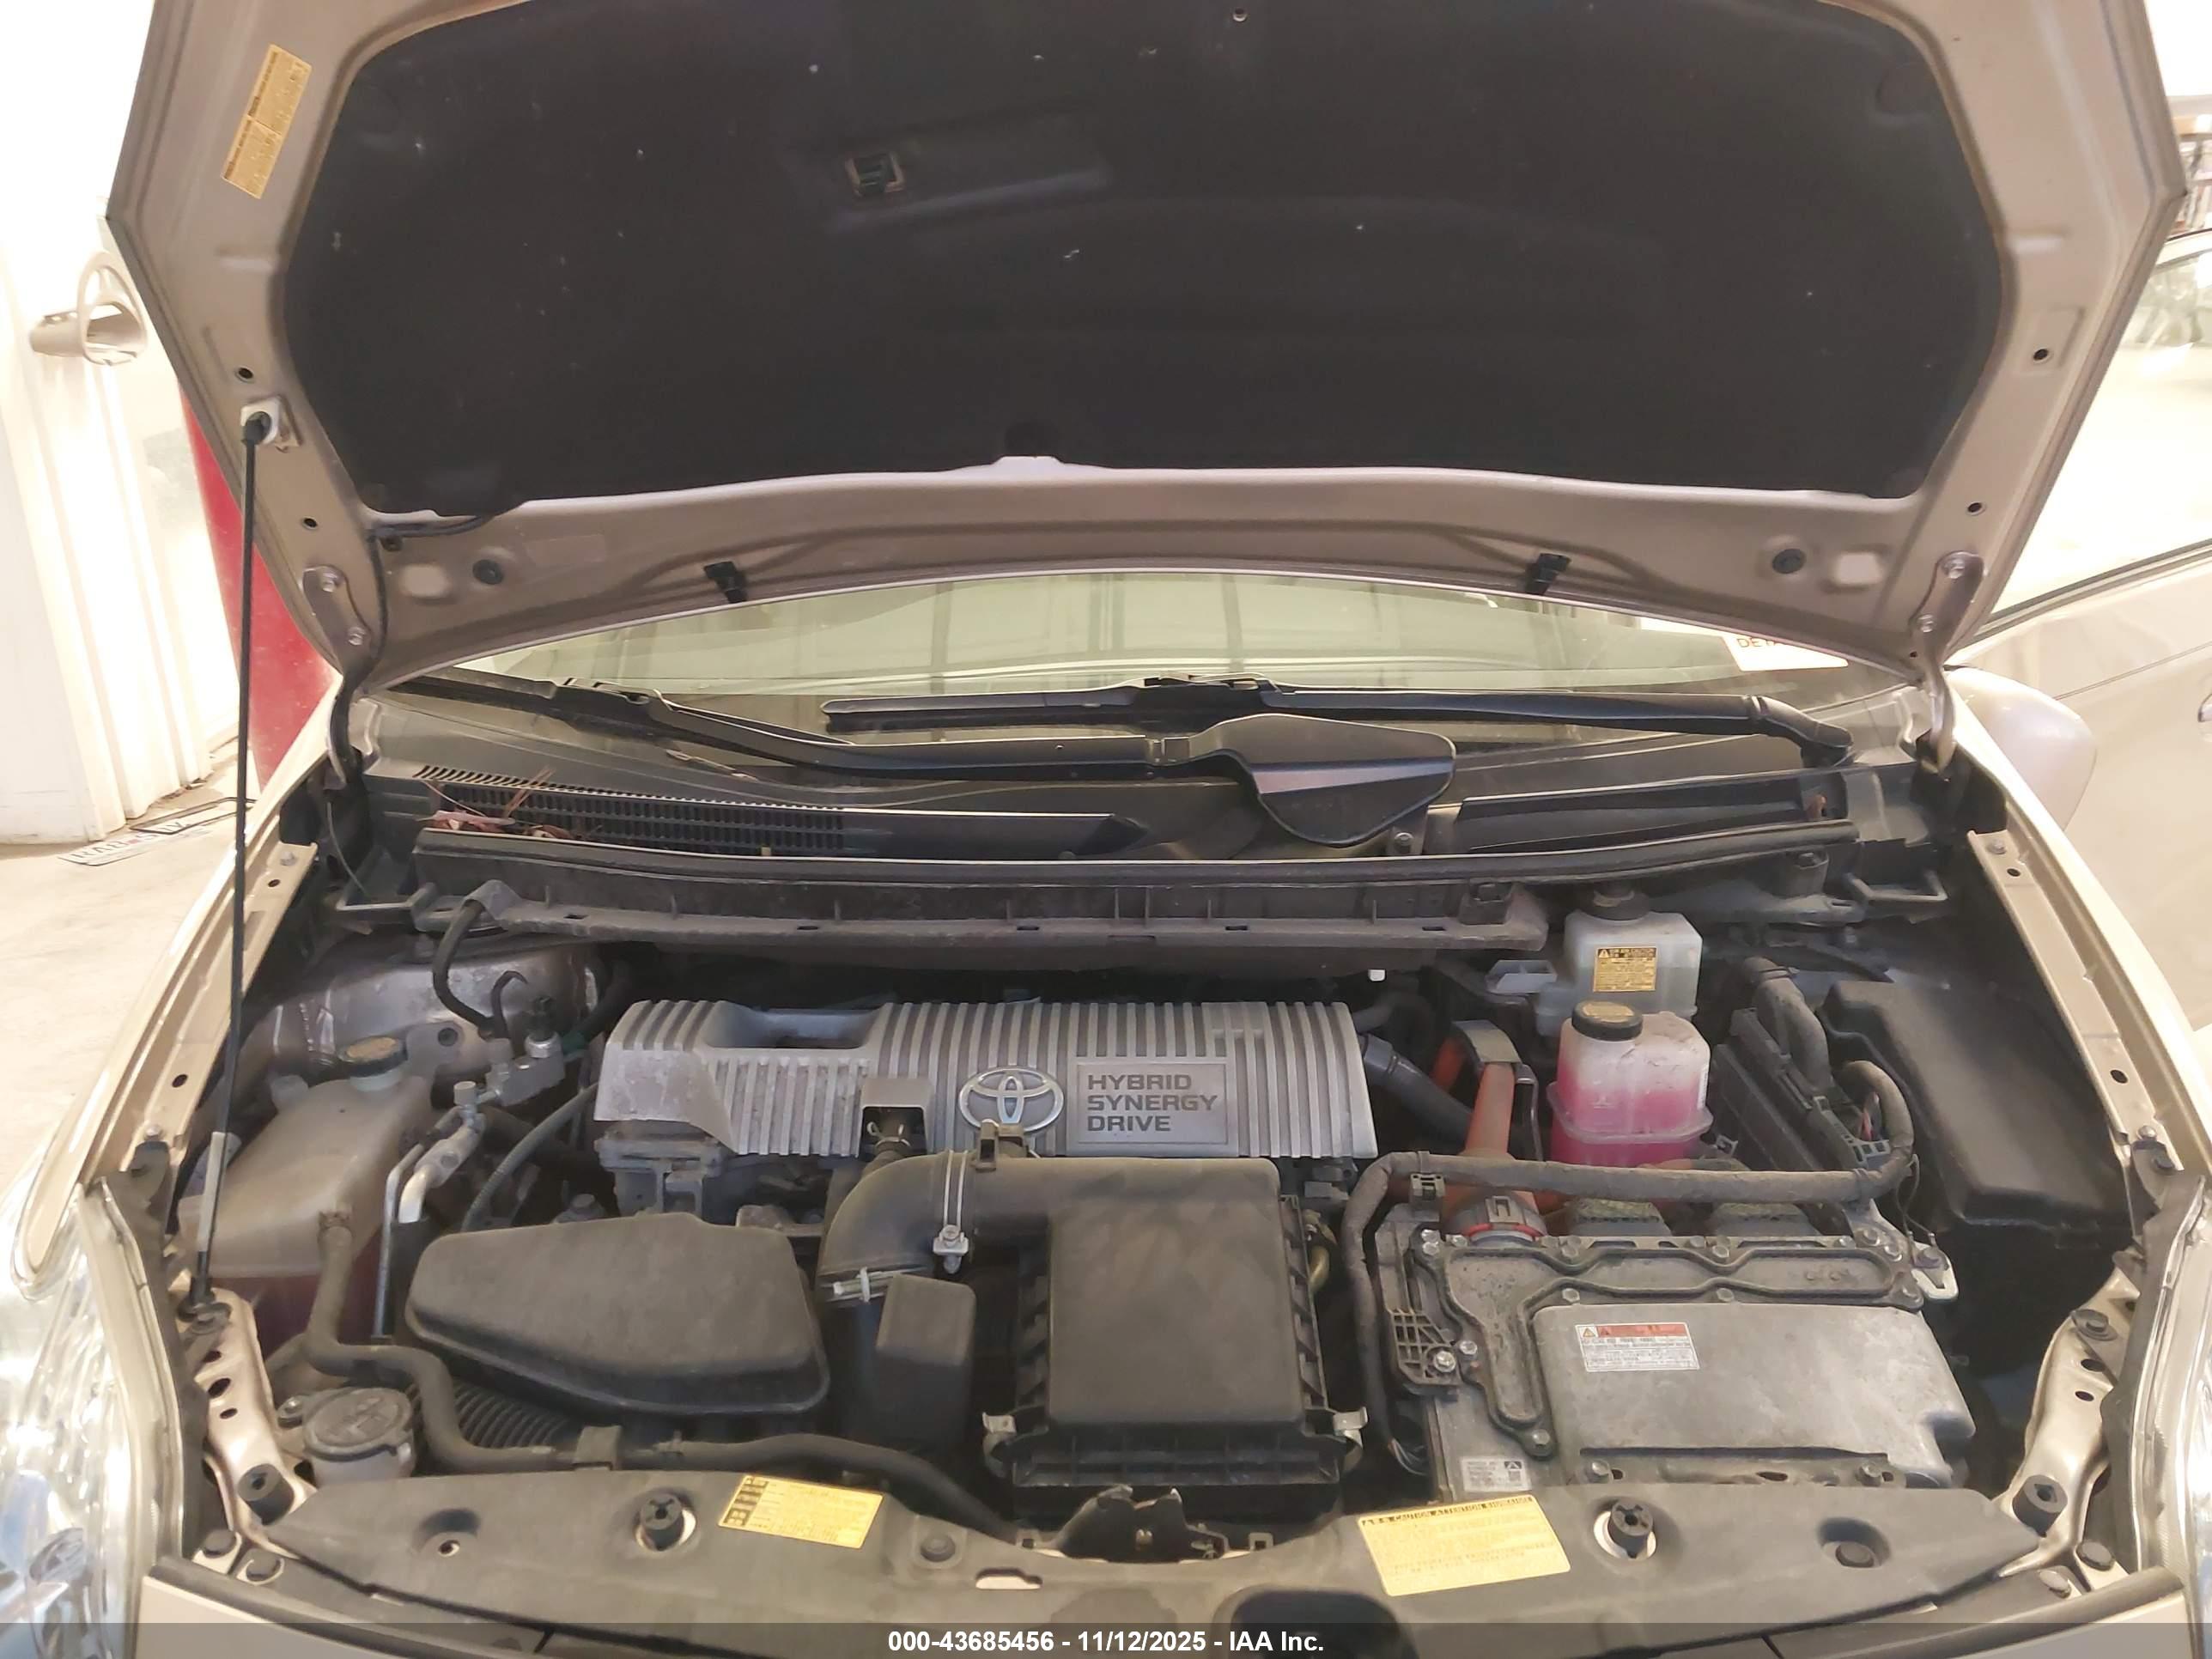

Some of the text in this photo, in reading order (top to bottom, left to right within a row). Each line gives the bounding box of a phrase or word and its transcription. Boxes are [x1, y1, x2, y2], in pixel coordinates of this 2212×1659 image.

[1088, 1074, 1192, 1091] HYBRID
[1087, 1094, 1218, 1111] SYNERGY
[1087, 1115, 1171, 1132] DRIVE
